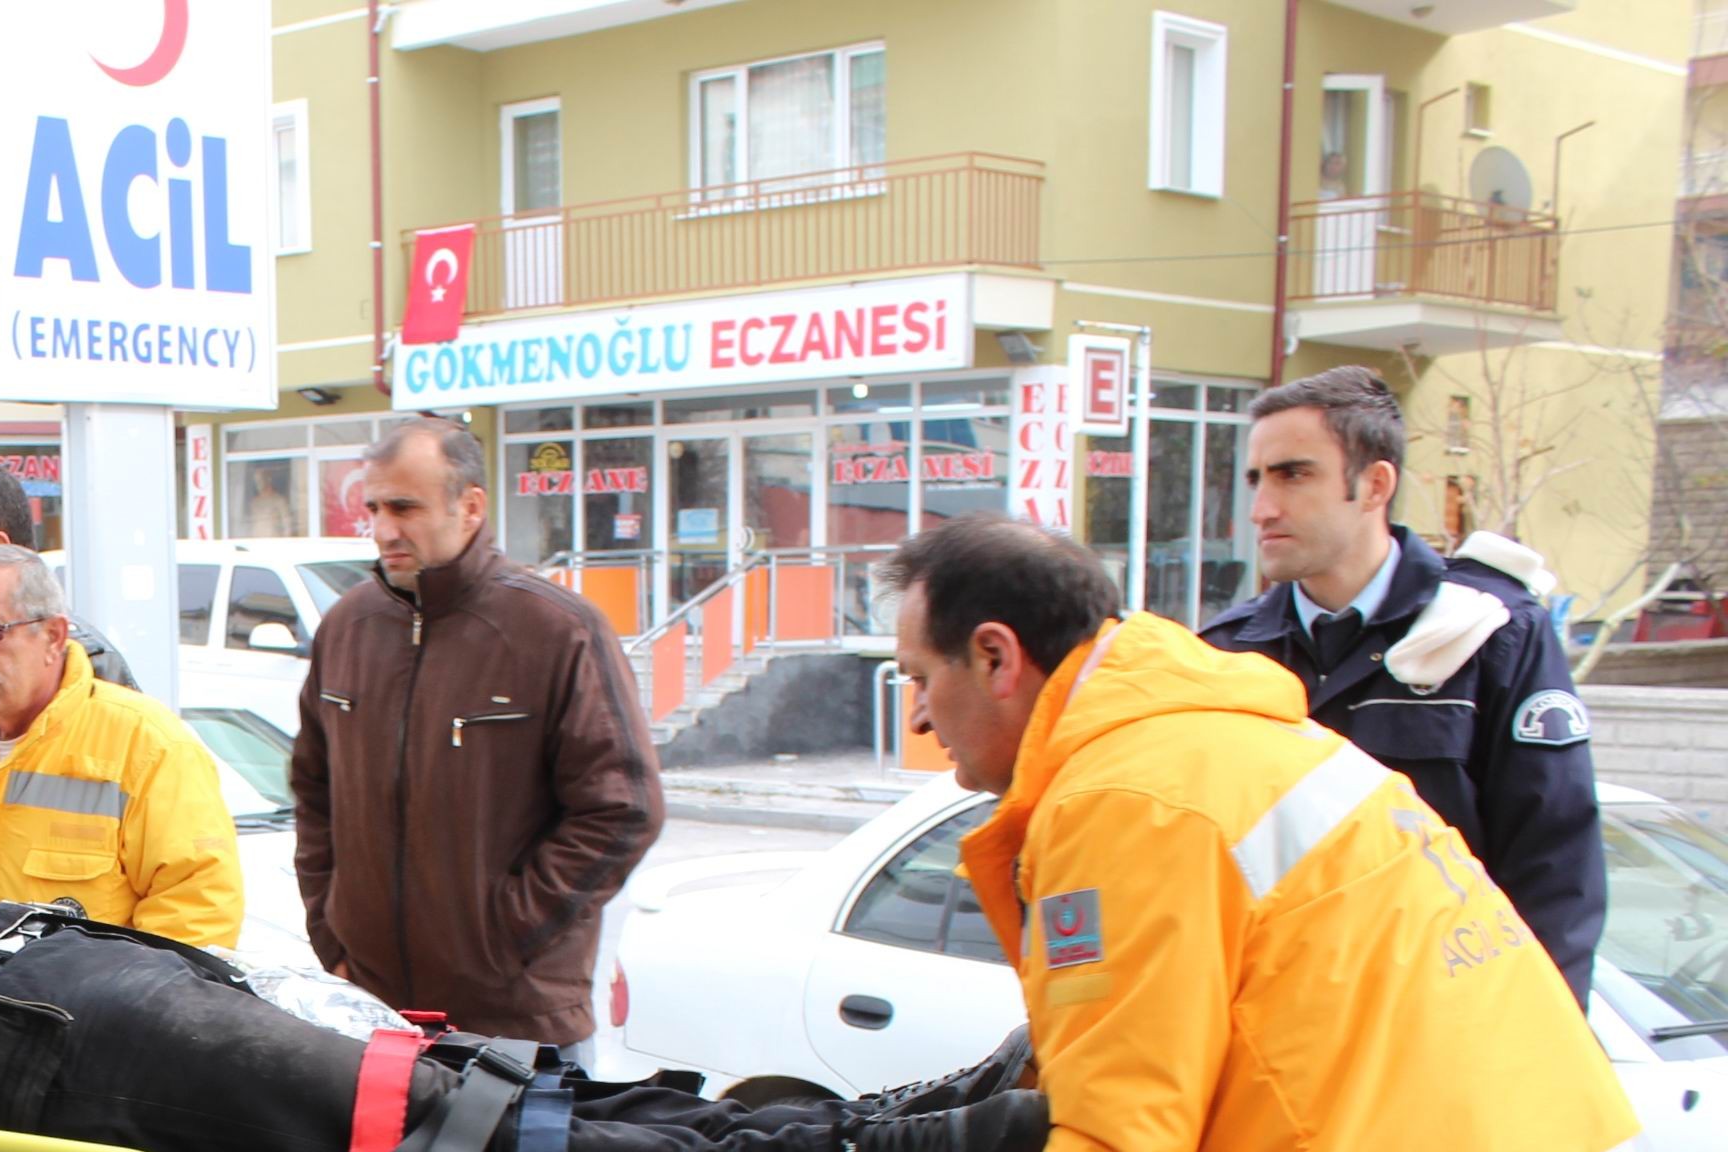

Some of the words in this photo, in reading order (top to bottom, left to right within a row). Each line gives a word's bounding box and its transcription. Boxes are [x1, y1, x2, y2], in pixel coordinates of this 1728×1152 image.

[12, 309, 255, 373] (EMERGENCY)
[406, 315, 692, 394] GÖKMENOĞLU
[710, 299, 947, 369] ECZANESİ
[1090, 359, 1116, 414] E
[191, 436, 209, 540] ECZA
[1019, 383, 1045, 527] ECZA
